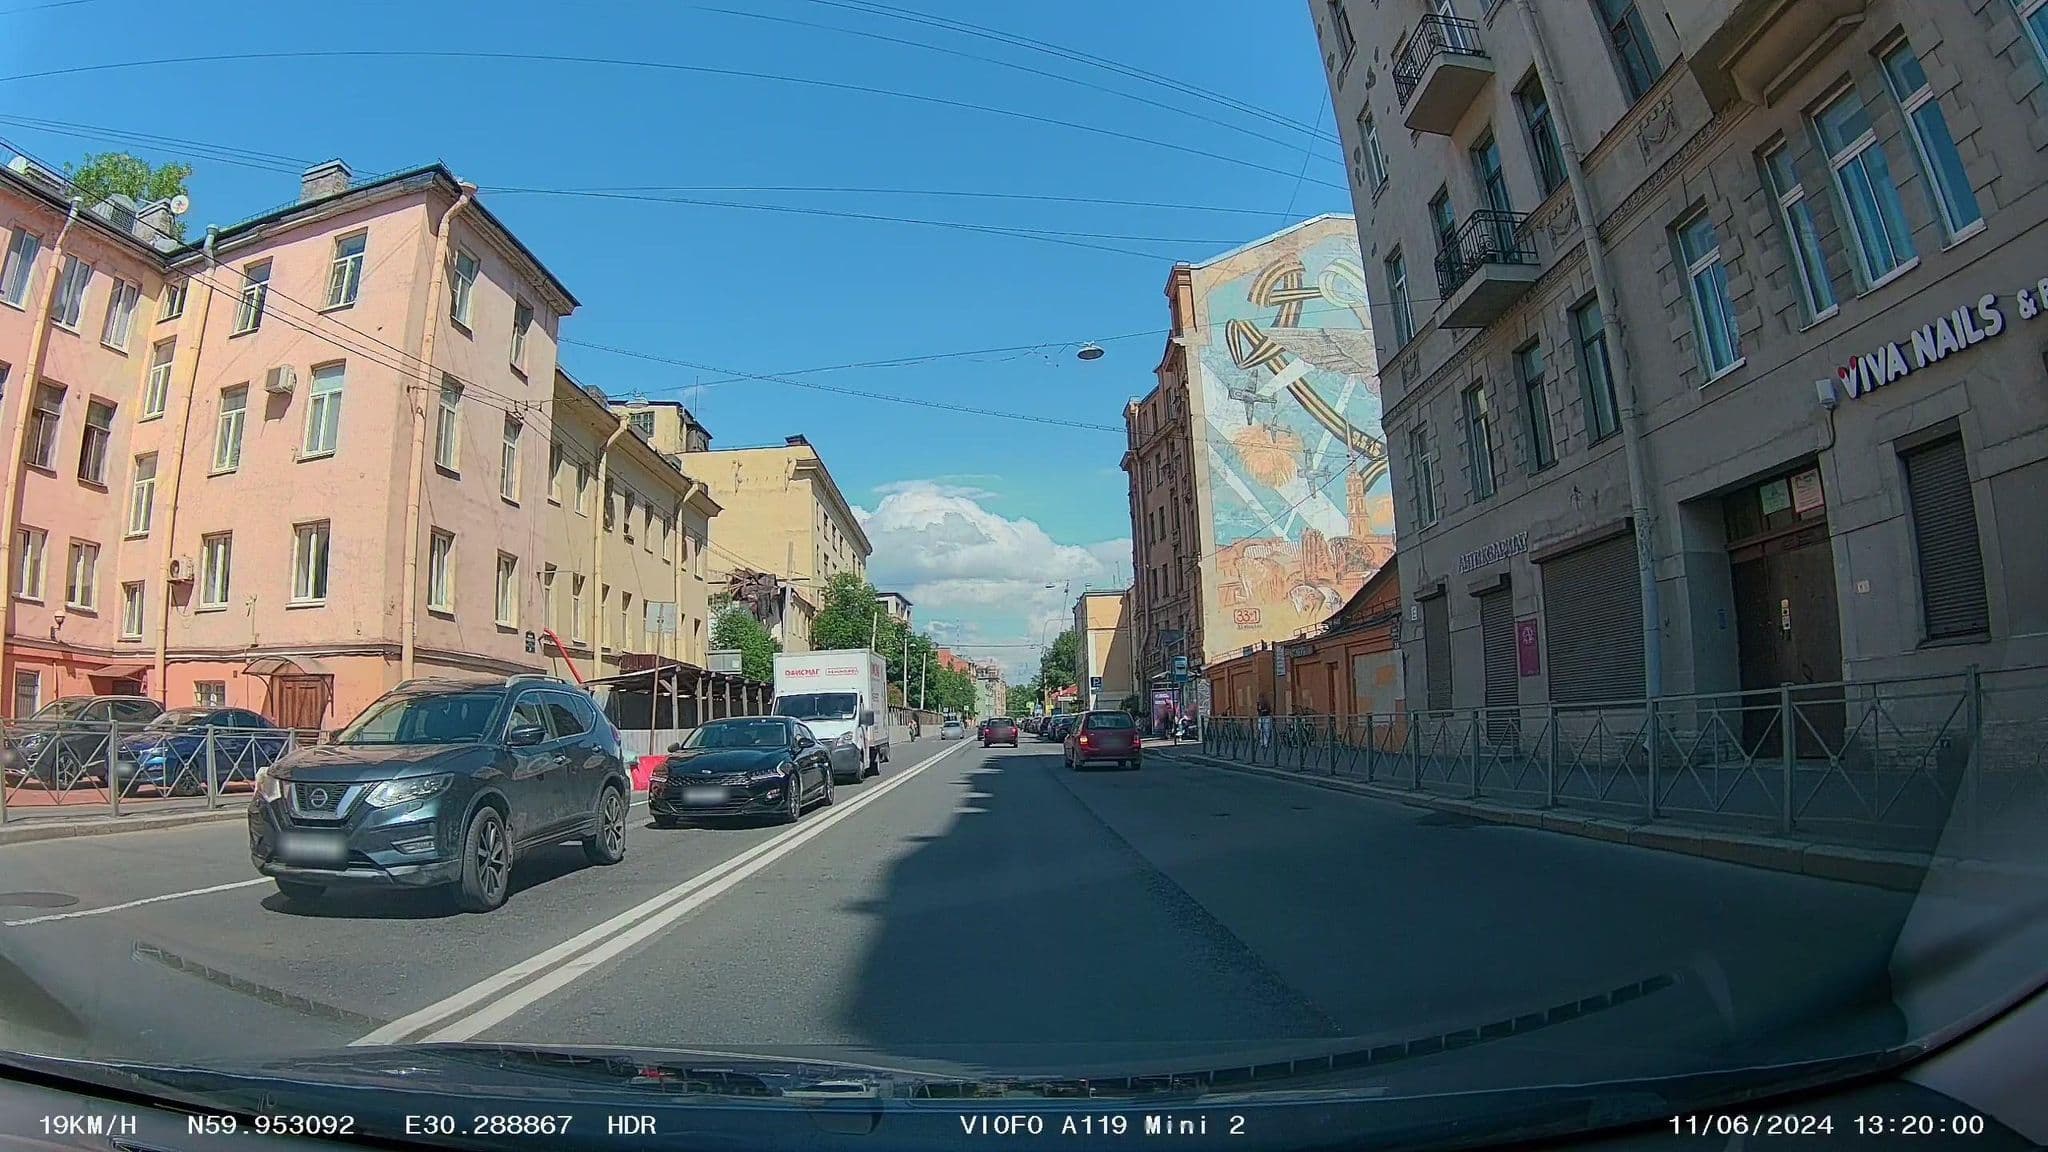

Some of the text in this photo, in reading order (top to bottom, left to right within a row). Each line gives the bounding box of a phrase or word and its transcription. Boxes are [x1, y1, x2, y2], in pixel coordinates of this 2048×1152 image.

[1837, 342, 1908, 399] VIVA
[1911, 293, 2003, 368] NAILS
[2016, 288, 2038, 320] &
